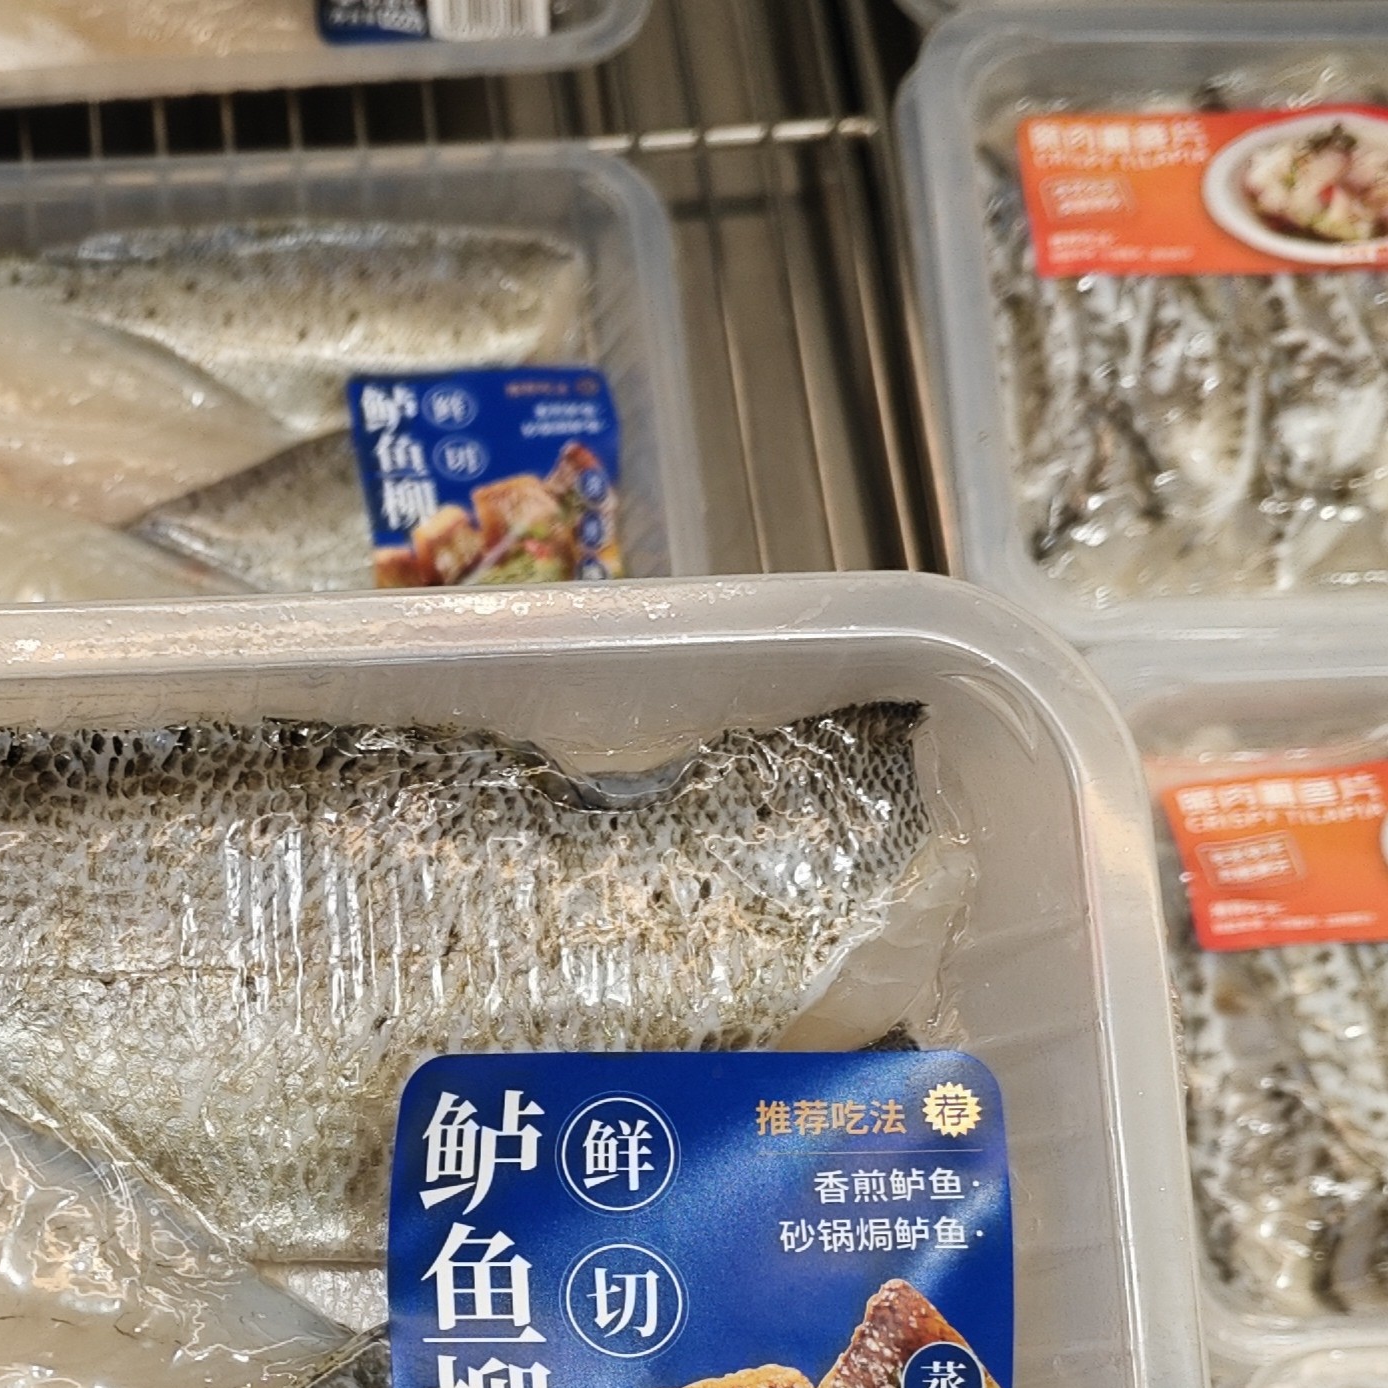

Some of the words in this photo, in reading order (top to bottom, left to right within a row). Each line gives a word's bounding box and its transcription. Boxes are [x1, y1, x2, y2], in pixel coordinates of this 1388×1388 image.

[756, 1100, 907, 1135] 推荐吃法
[933, 1094, 969, 1126] 荐
[582, 1119, 654, 1191] 鲜
[814, 1167, 964, 1203] 香煎鲈鱼
[780, 1216, 969, 1253] 砂锅焗鲈鱼
[586, 1268, 659, 1338] 切
